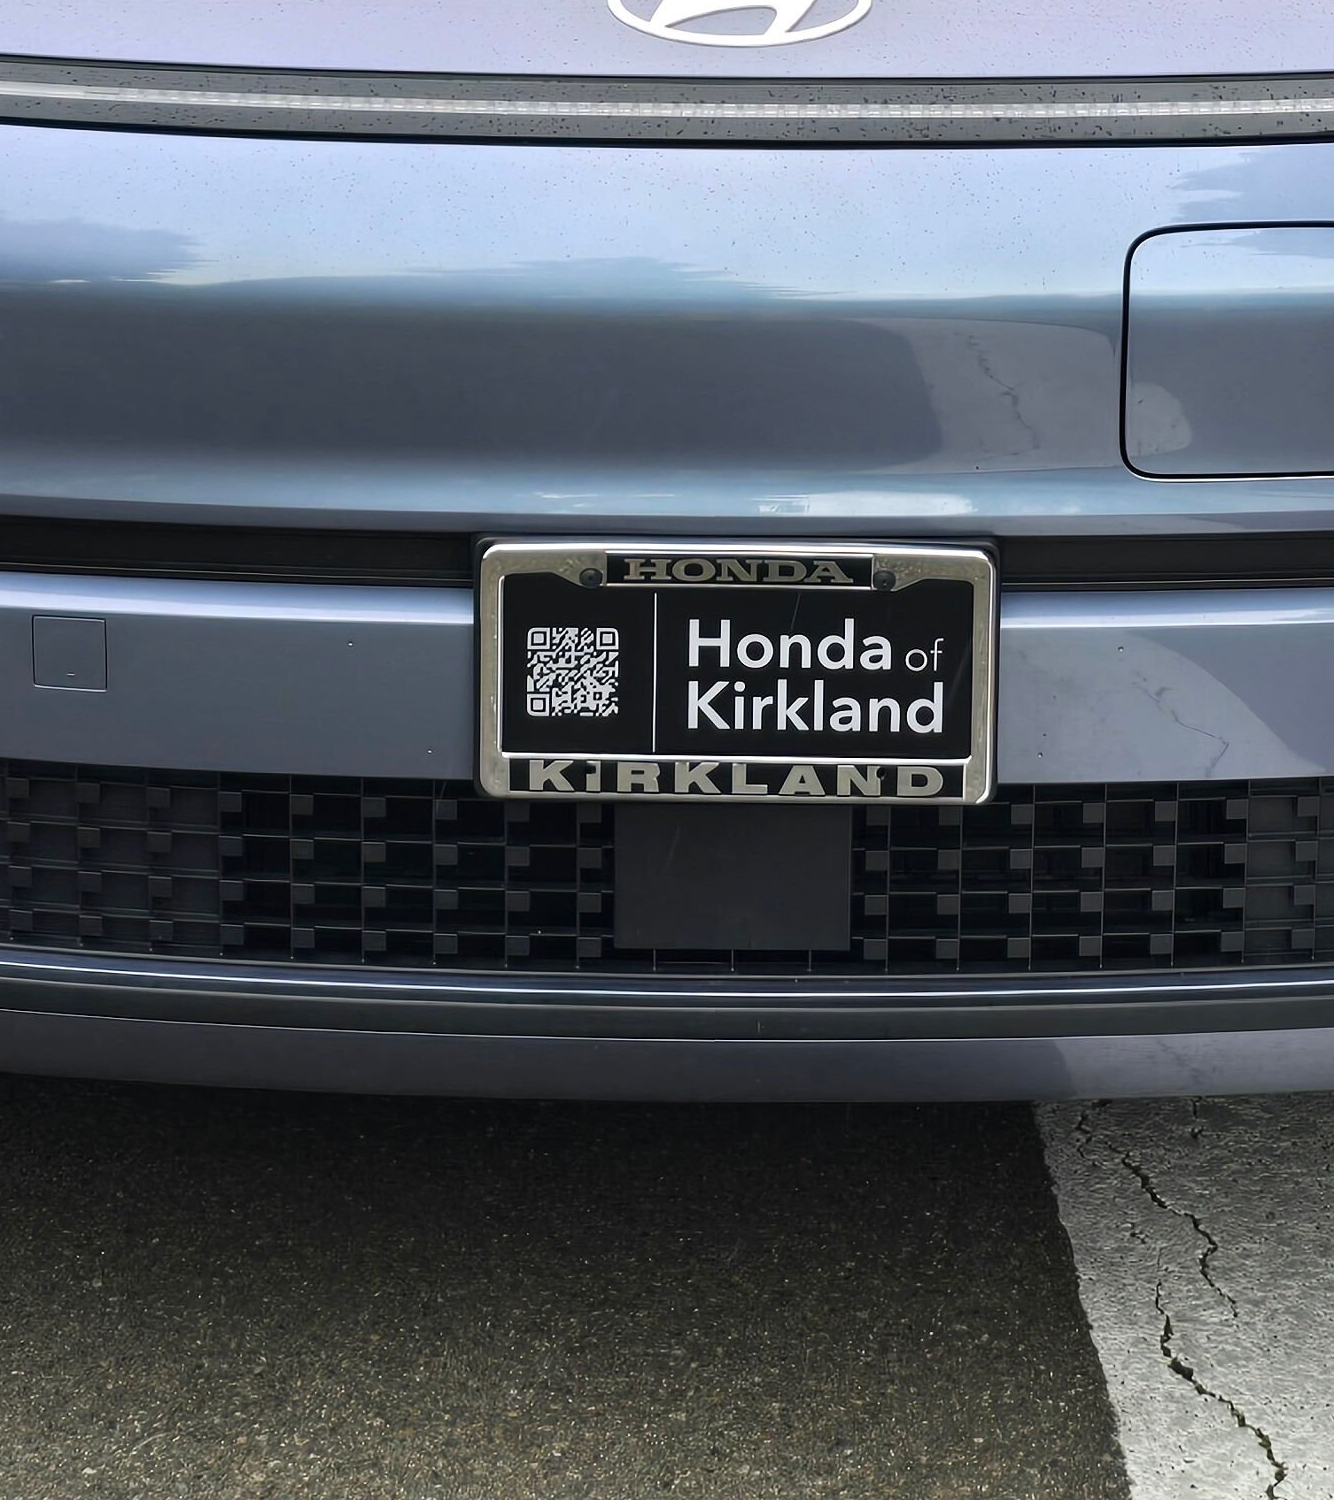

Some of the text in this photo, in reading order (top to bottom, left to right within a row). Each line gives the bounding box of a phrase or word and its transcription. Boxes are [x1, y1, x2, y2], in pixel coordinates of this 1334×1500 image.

[623, 558, 854, 583] HONDA
[688, 617, 945, 672] Honda of
[687, 678, 944, 734] Kirkland
[528, 758, 945, 798] KIRKLAND
